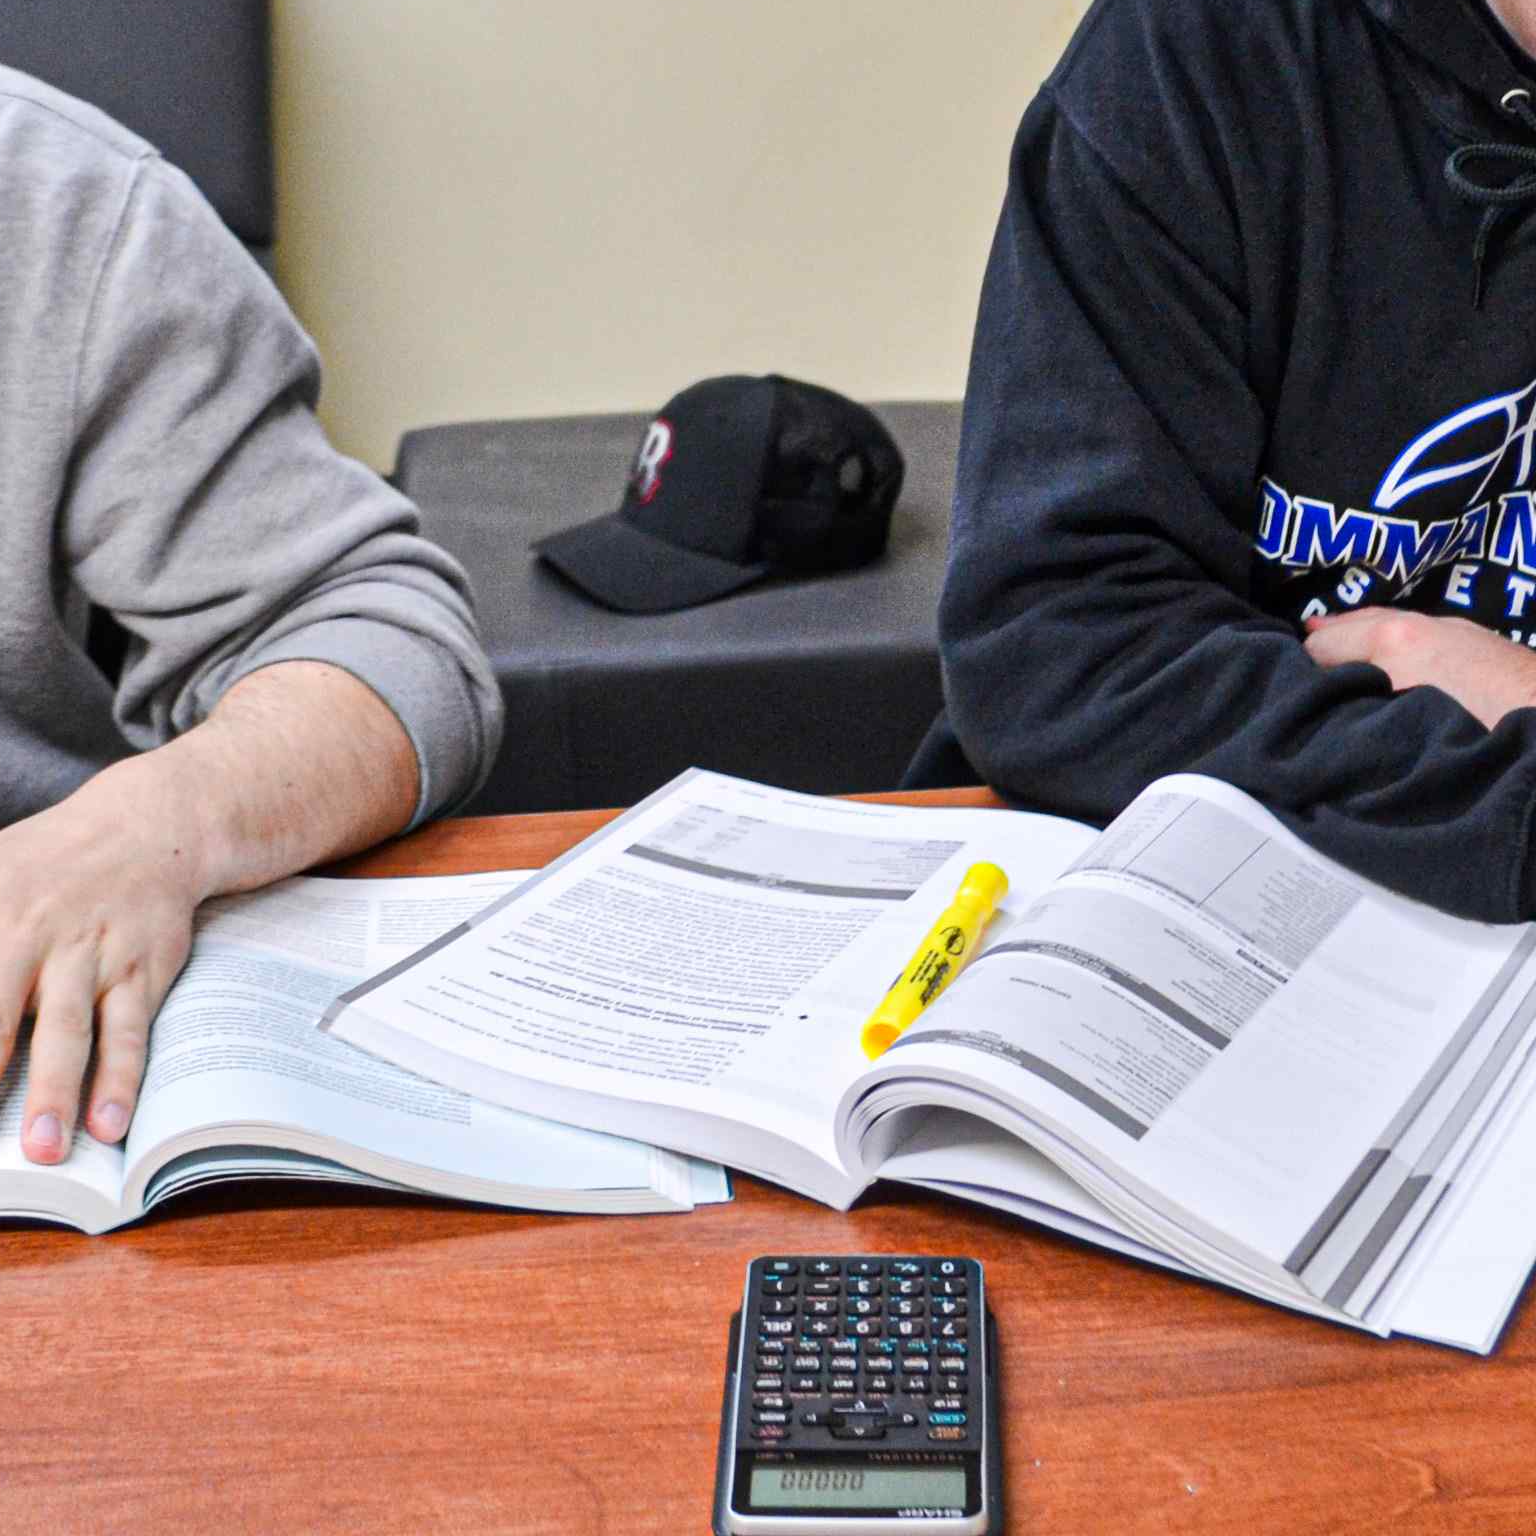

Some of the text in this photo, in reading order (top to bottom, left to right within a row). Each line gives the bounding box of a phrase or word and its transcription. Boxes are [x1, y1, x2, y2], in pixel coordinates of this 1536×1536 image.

[857, 1301, 956, 1313] 4 5 6
[763, 1321, 955, 1333] 7 8 9 DEL
